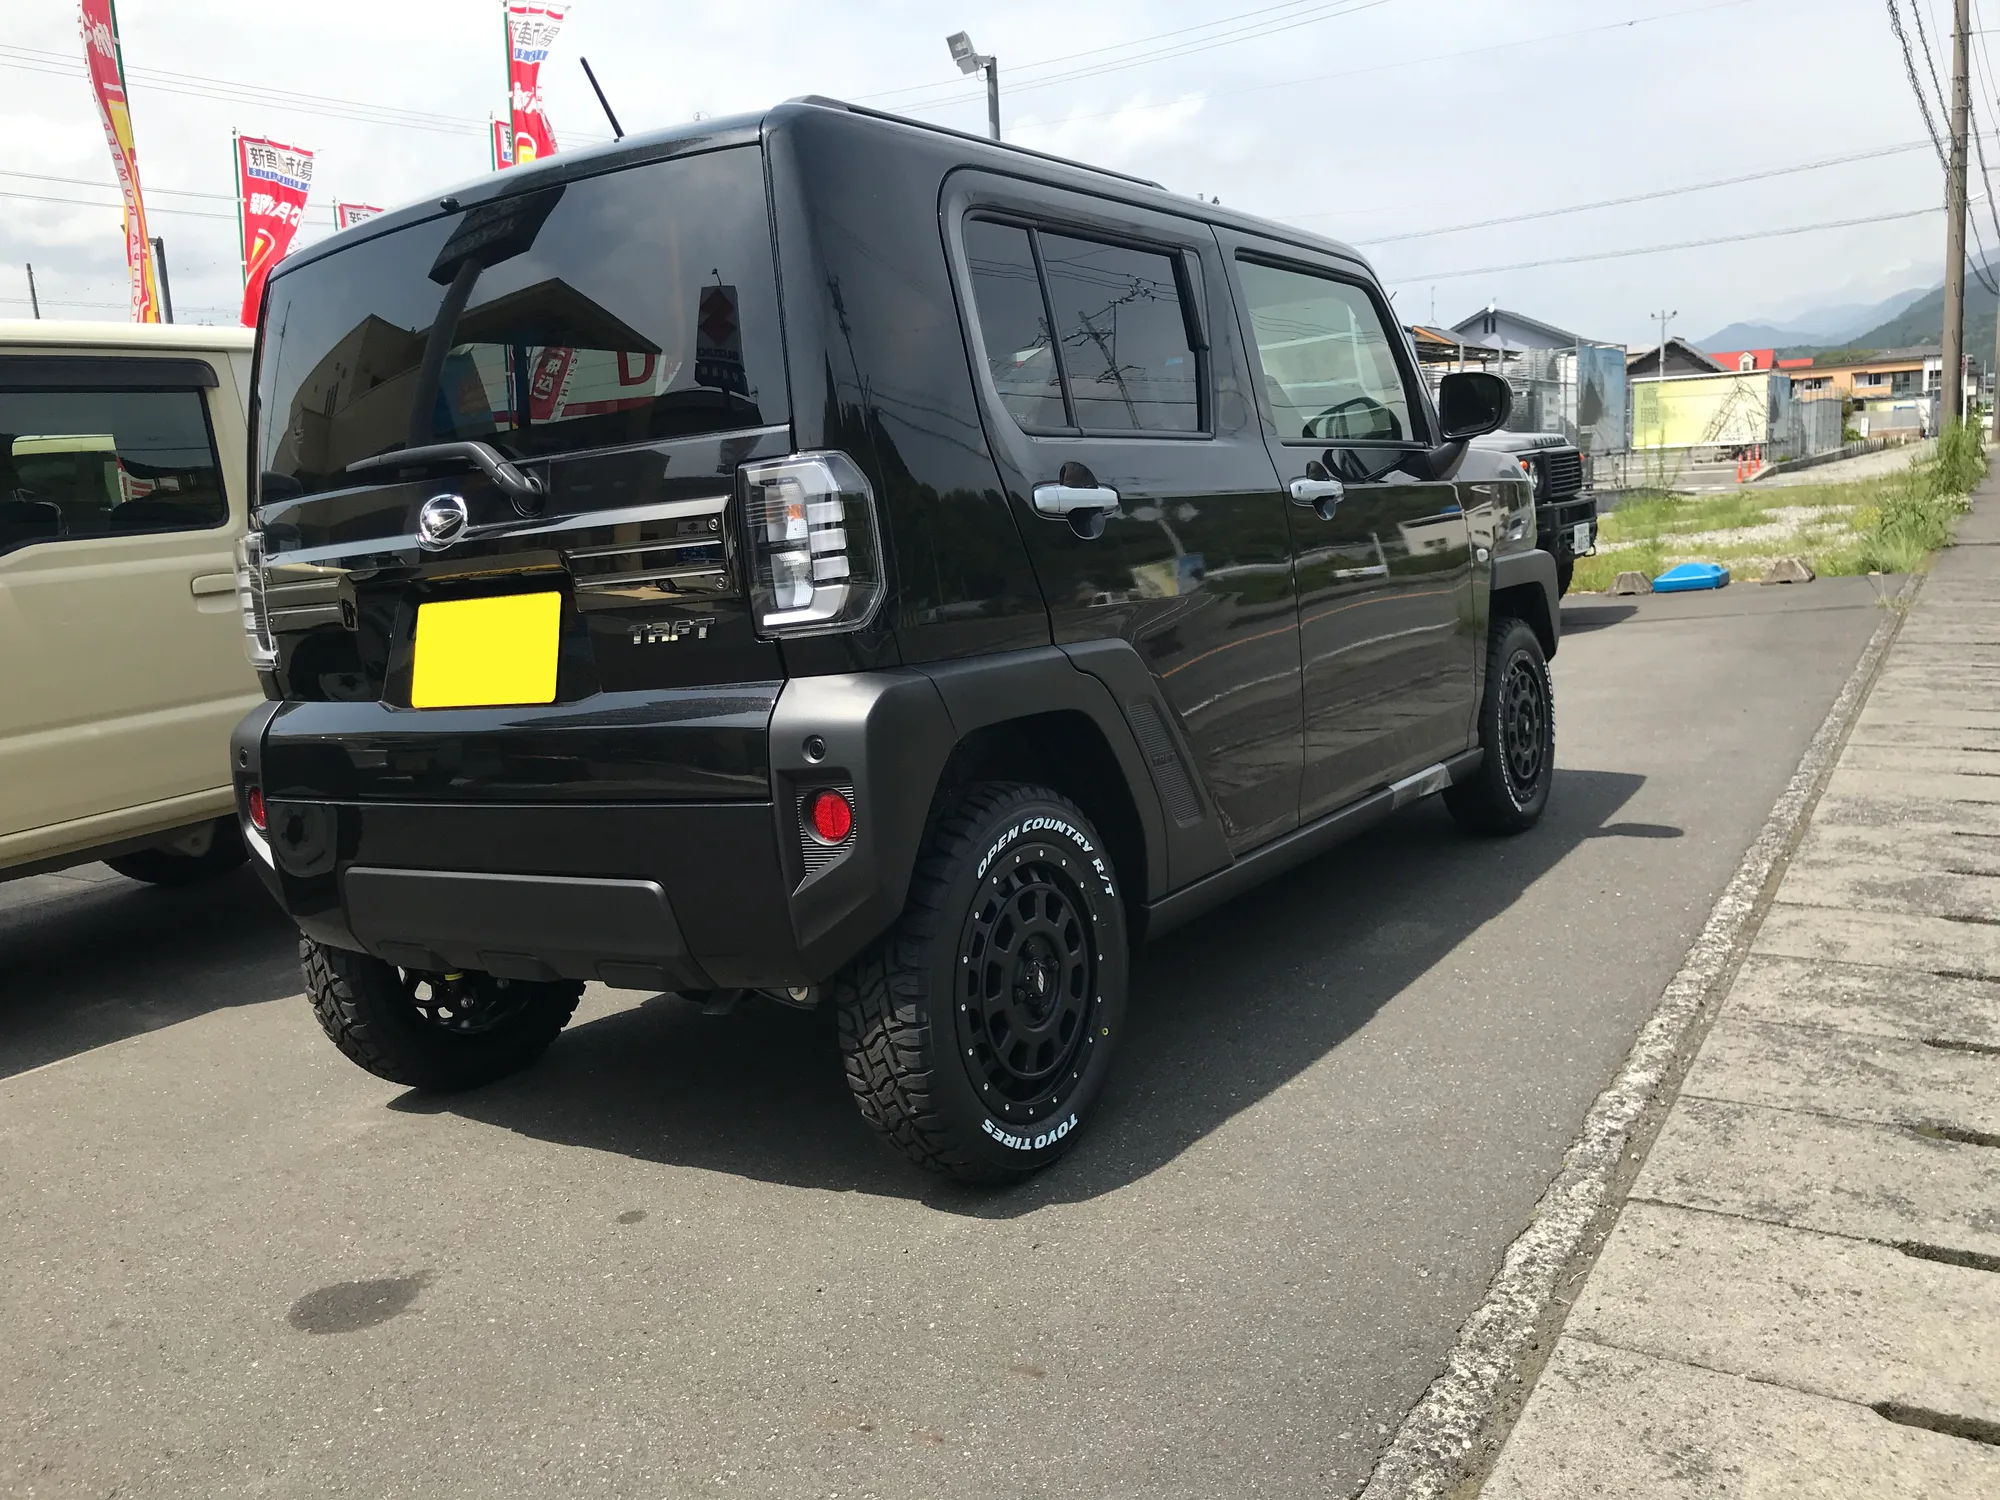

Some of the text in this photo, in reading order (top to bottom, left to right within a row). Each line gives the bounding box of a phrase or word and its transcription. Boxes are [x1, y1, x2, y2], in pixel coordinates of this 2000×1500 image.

[628, 617, 715, 645] TAFT
[977, 817, 1115, 897] OPEN COUNTRY R/T
[981, 1112, 1079, 1151] TOYO TIRES
